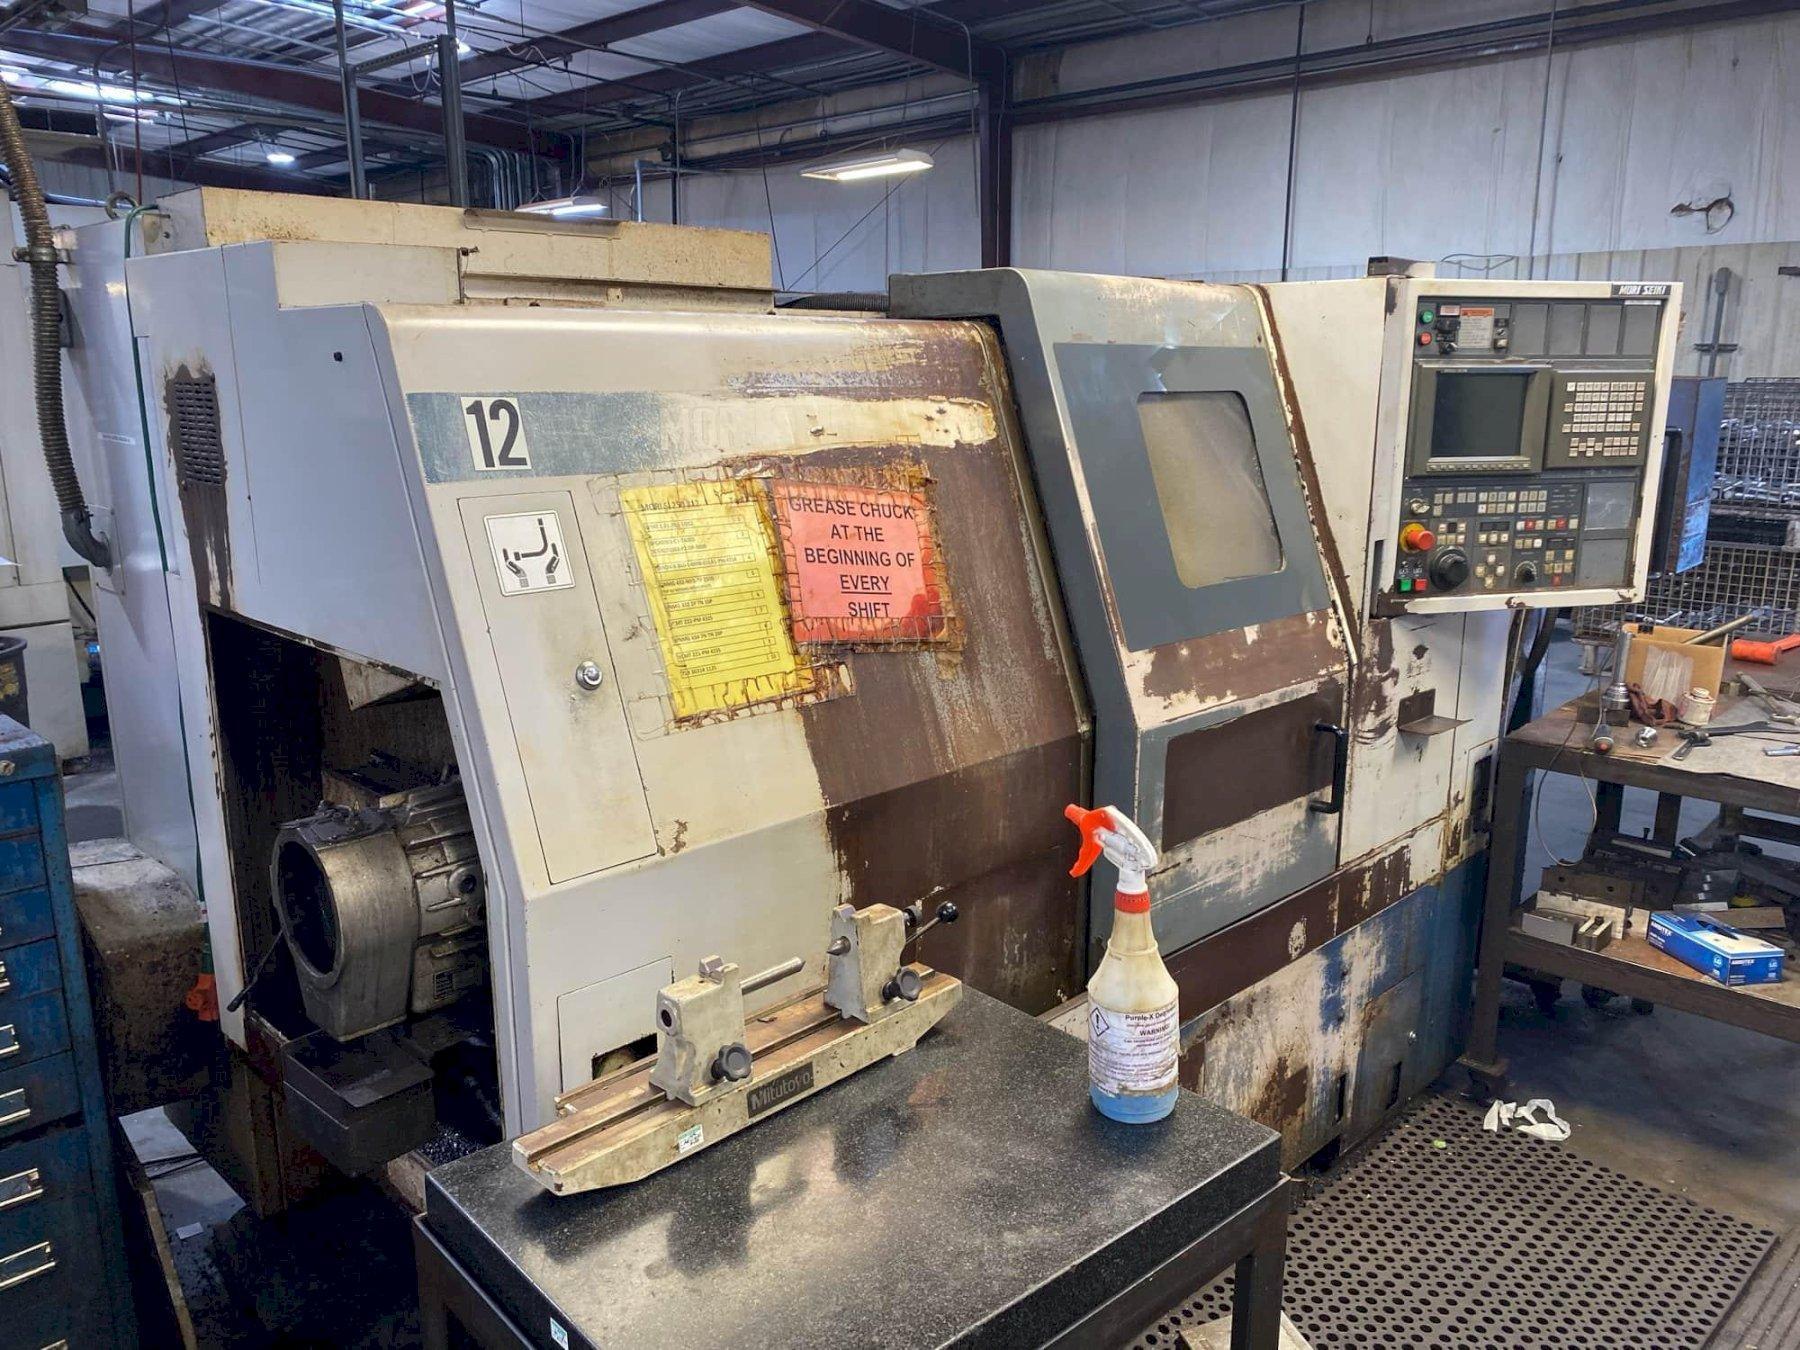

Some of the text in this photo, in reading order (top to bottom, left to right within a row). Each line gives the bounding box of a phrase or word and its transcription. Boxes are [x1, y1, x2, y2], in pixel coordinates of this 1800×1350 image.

[1619, 285, 1666, 295] MORI SEIKI
[466, 399, 528, 468] 12
[790, 497, 914, 520] GREASE CHUCK
[831, 524, 885, 542] AT THE
[804, 547, 915, 568] BEGINNING OF
[840, 574, 890, 591] EVERY
[848, 602, 890, 619] SHIFT
